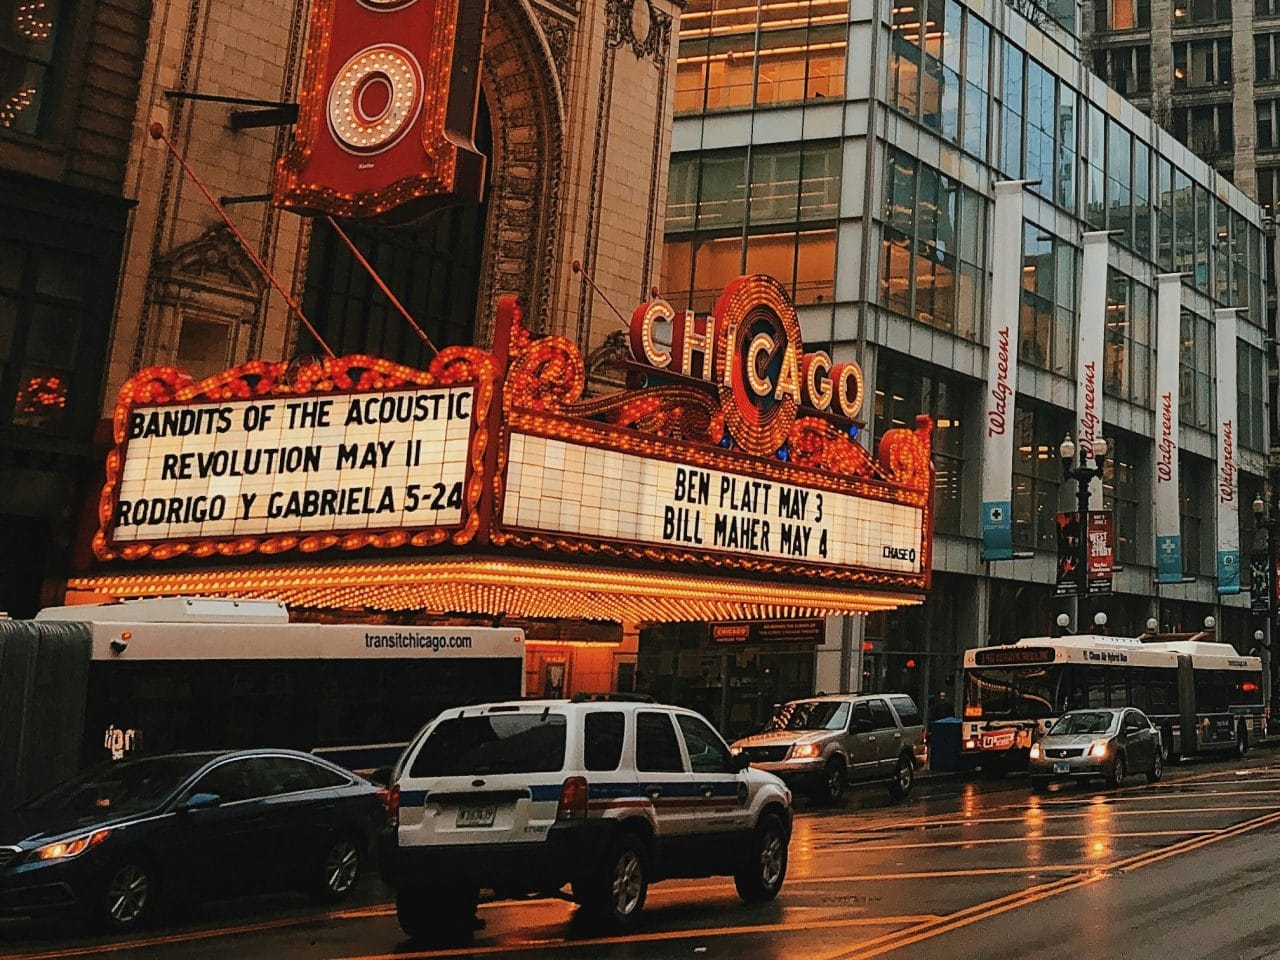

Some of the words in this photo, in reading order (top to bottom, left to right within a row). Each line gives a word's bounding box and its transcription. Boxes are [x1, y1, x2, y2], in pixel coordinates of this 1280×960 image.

[638, 298, 864, 418] CHICAGO
[988, 326, 1013, 438] Walgreens
[128, 406, 234, 440] BANDITS
[243, 404, 276, 432] OF
[286, 400, 334, 430] THE
[343, 392, 472, 426] ACOUSTIC
[1079, 361, 1100, 460] Walgreens
[1158, 392, 1178, 484] Walgreens
[161, 445, 323, 480] REVOLUTION
[336, 440, 396, 471] MAY
[1220, 420, 1238, 505] Walgreens
[115, 495, 227, 528] RODRIGO
[241, 492, 257, 521] Y
[267, 485, 395, 518] GABRIELA
[403, 482, 464, 513] 5-24
[674, 467, 711, 506] BEN
[719, 475, 772, 515] PLATT
[778, 486, 809, 521] MAY
[814, 493, 823, 523] 3
[662, 505, 703, 545] BILL
[713, 513, 770, 552] MAHER
[780, 523, 812, 557] MAY
[818, 528, 828, 559] 4
[883, 546, 909, 561] CHASE
[364, 632, 473, 652] transitchicago.com
